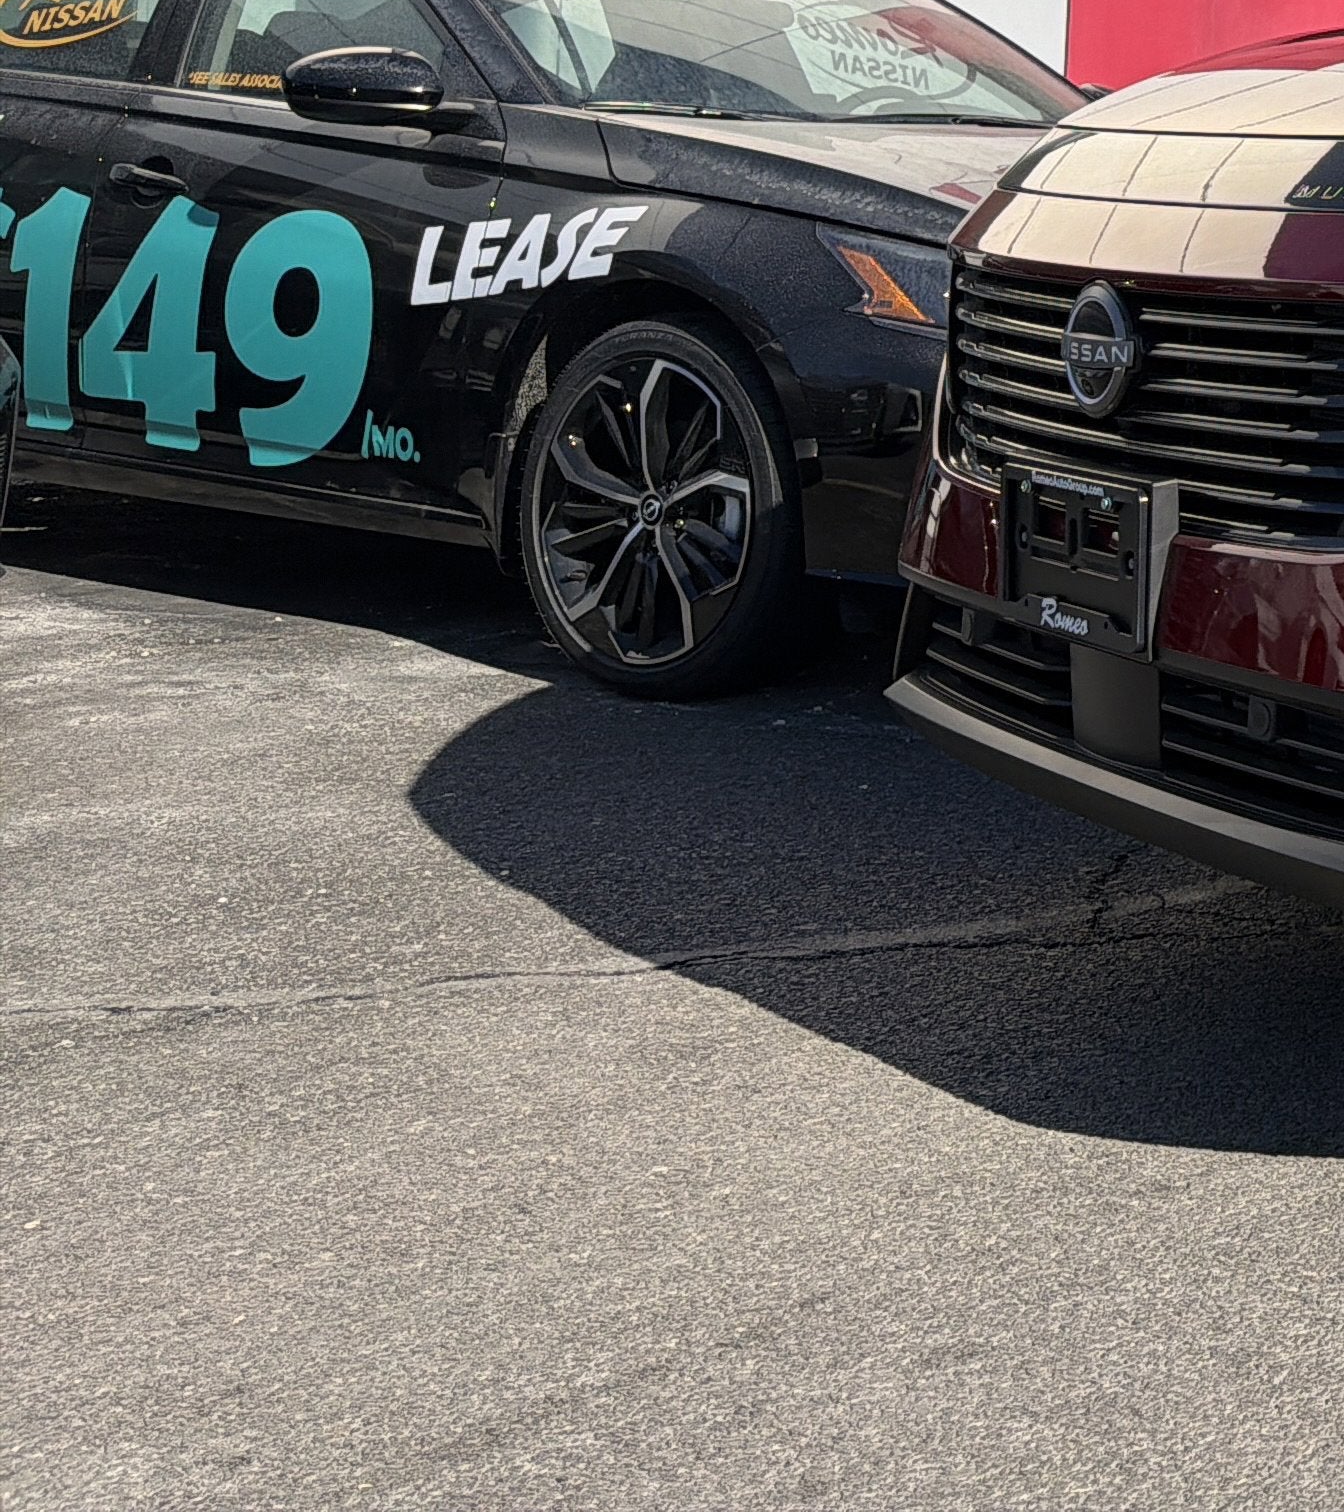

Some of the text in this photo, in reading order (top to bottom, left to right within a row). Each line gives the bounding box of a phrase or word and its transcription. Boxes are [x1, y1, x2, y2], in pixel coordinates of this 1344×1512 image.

[210, 72, 242, 86] SALES
[410, 205, 649, 306] LEASE
[0, 186, 374, 468] 149
[1040, 597, 1089, 636] Romeo
